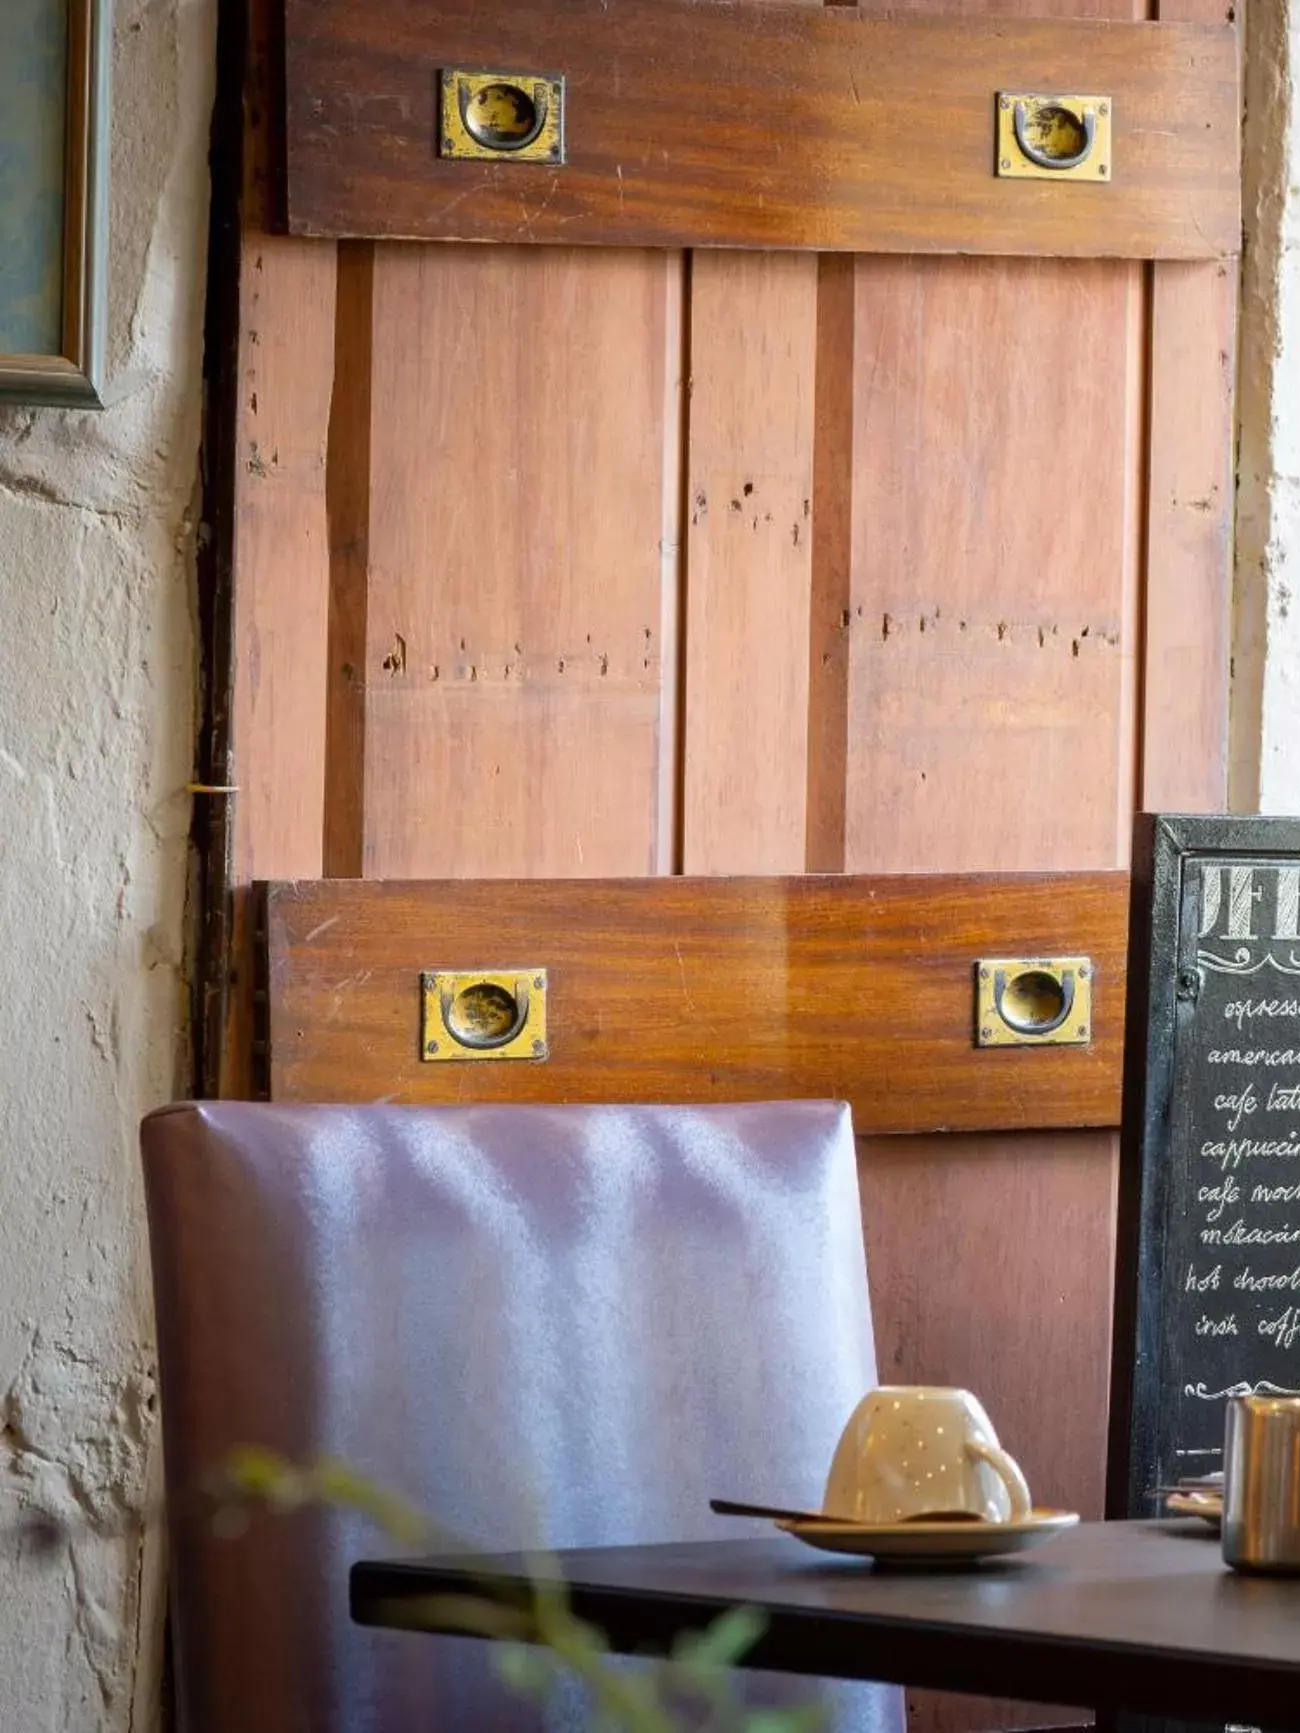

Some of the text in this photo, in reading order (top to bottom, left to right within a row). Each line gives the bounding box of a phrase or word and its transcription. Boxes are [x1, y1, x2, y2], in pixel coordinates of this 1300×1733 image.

[1214, 1083, 1258, 1131] cafe
[1199, 1175, 1240, 1223] cafe
[1185, 1263, 1222, 1292] hot
[1195, 1313, 1239, 1336] irish
